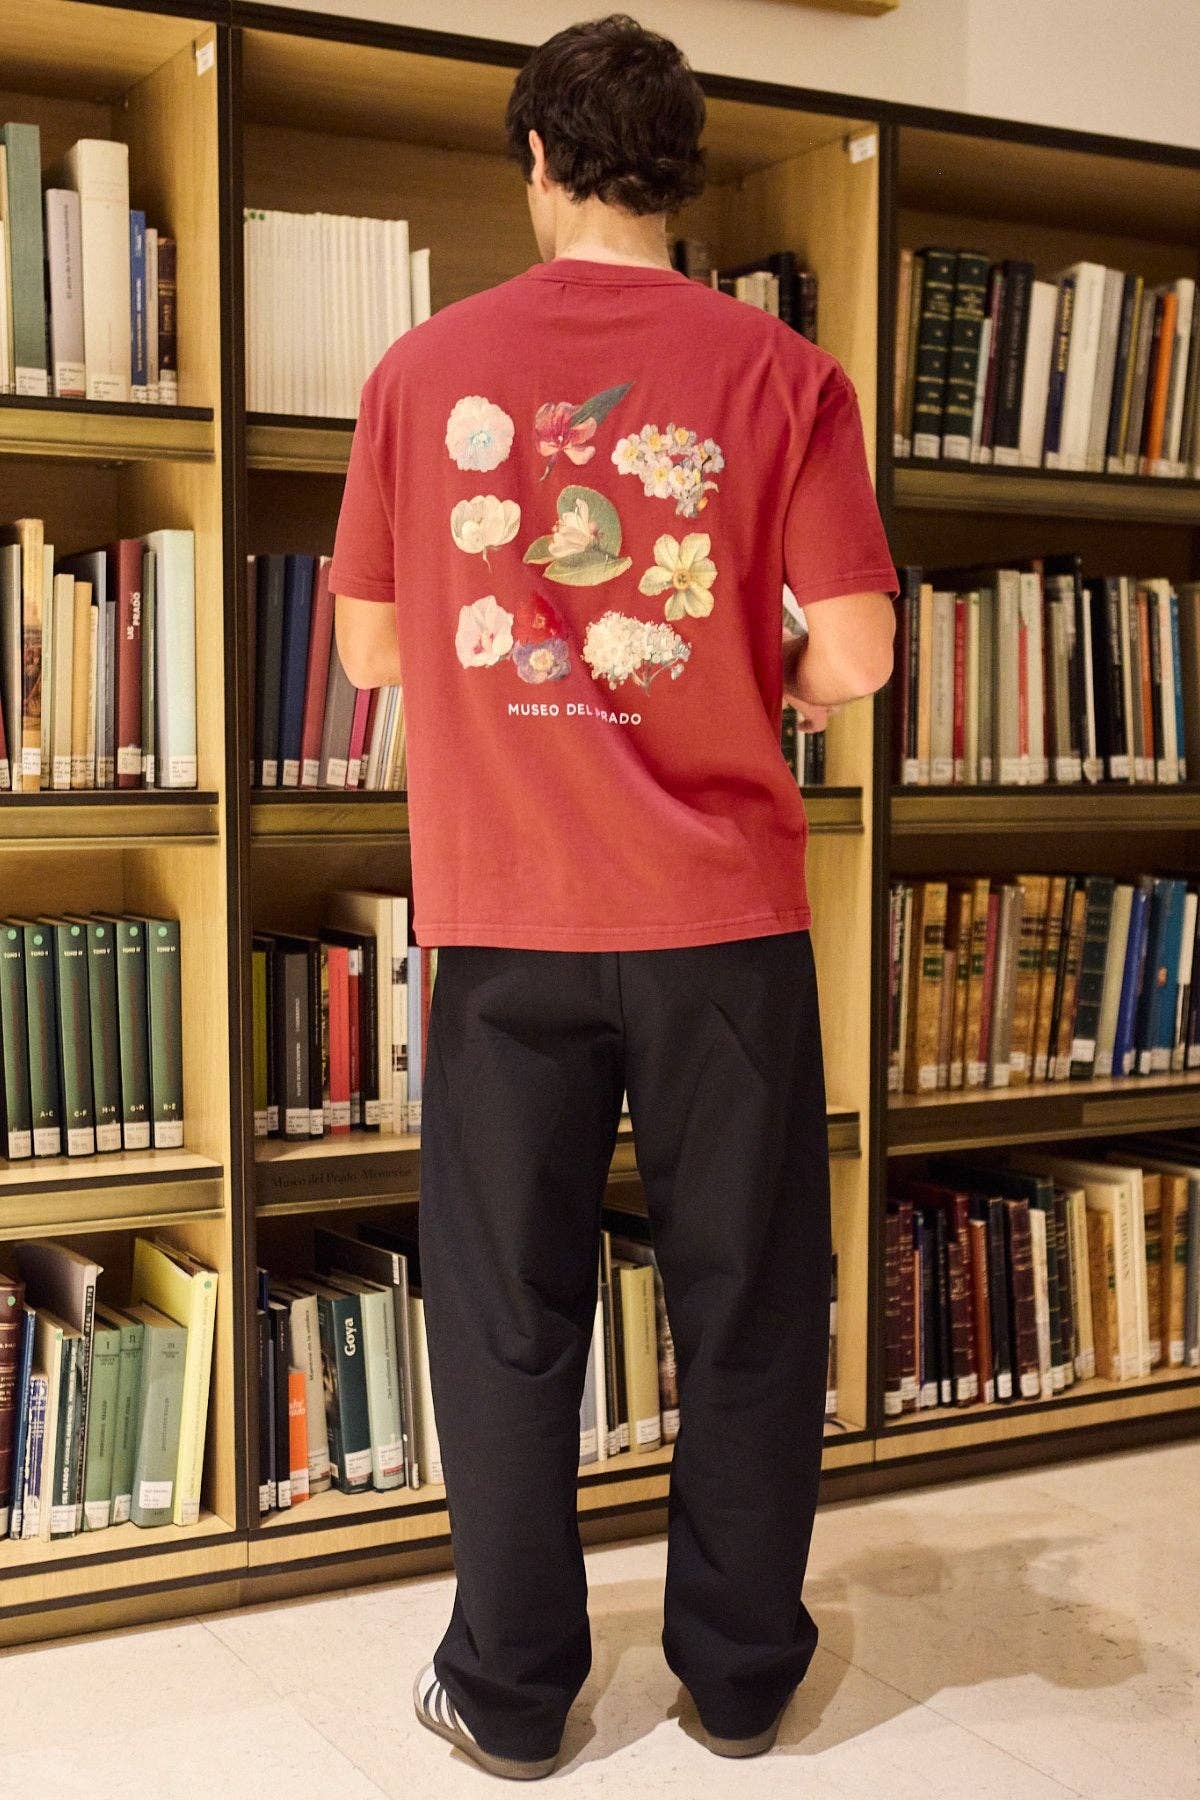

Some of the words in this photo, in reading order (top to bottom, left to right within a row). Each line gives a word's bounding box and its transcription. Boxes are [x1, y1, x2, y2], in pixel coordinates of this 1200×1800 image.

[507, 703, 559, 717] MUSEO
[566, 703, 593, 716] DEL
[594, 707, 642, 725] PRADO
[344, 1317, 357, 1357] Goya
